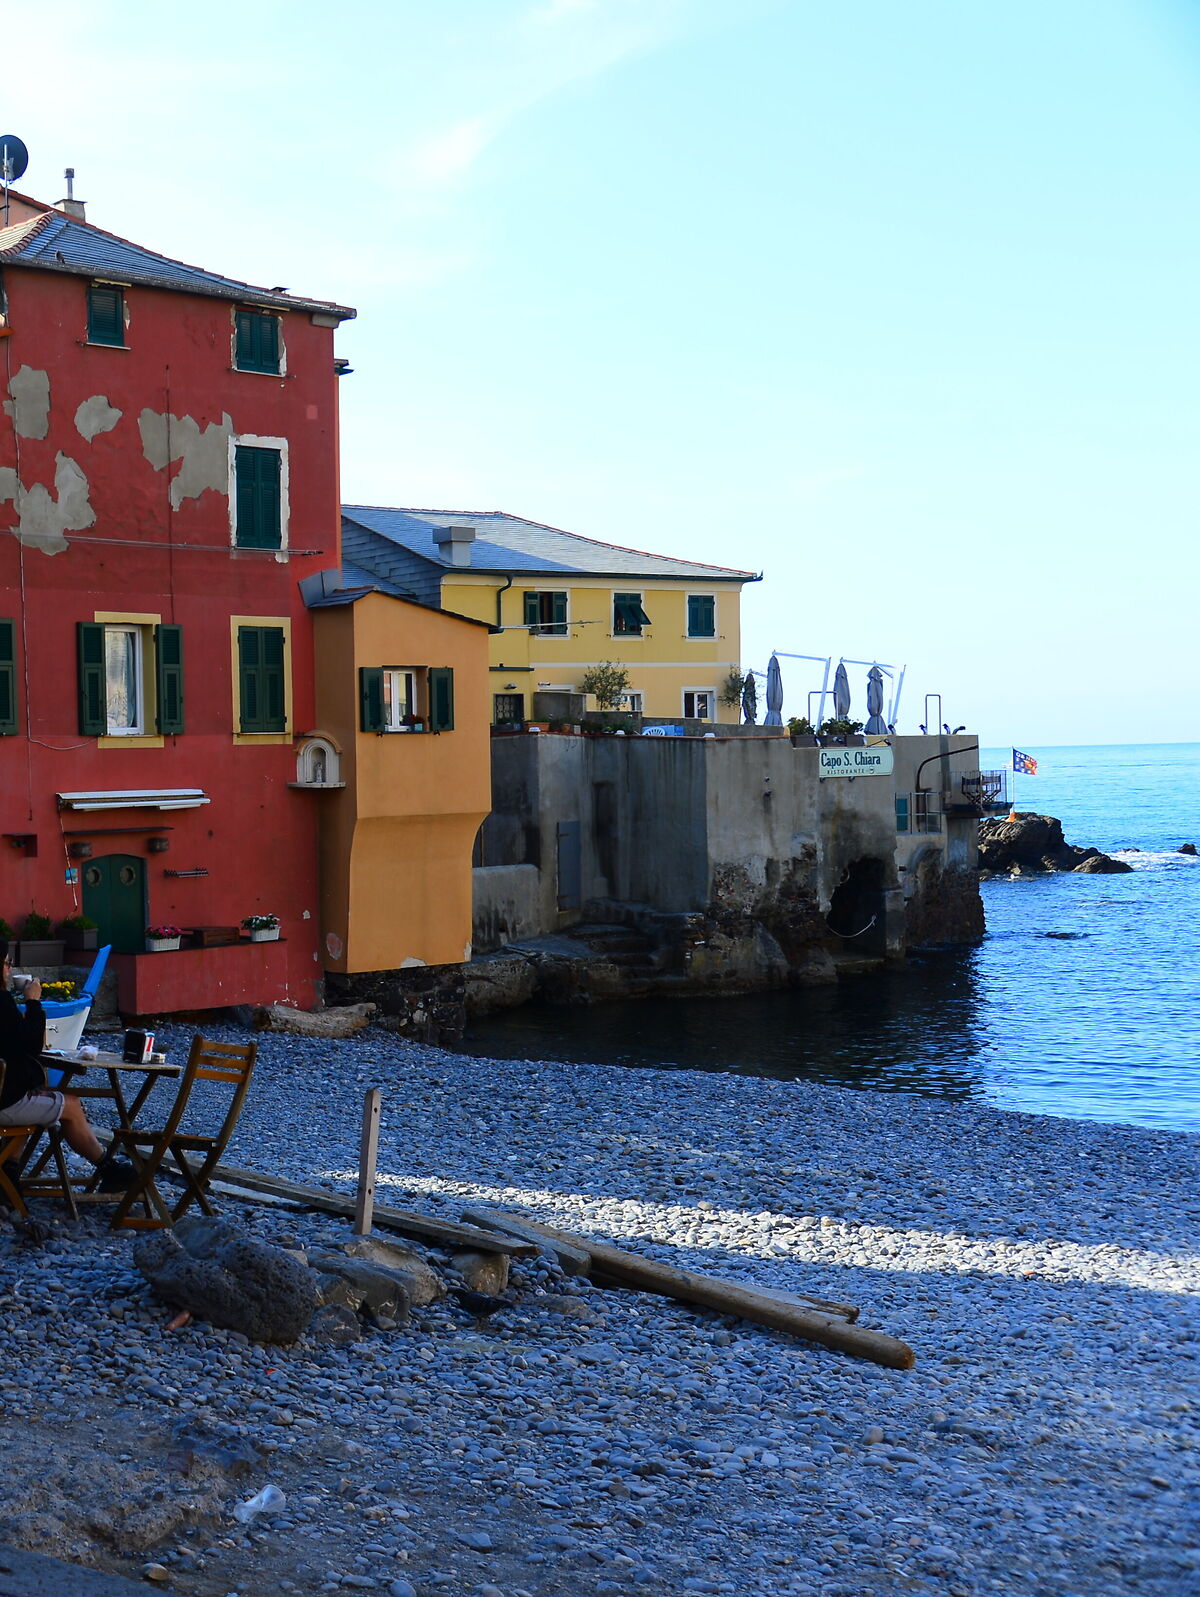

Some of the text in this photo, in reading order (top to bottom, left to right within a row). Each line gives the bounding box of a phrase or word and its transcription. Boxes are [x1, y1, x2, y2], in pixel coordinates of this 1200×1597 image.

[821, 751, 881, 769] Capo S. Chiara
